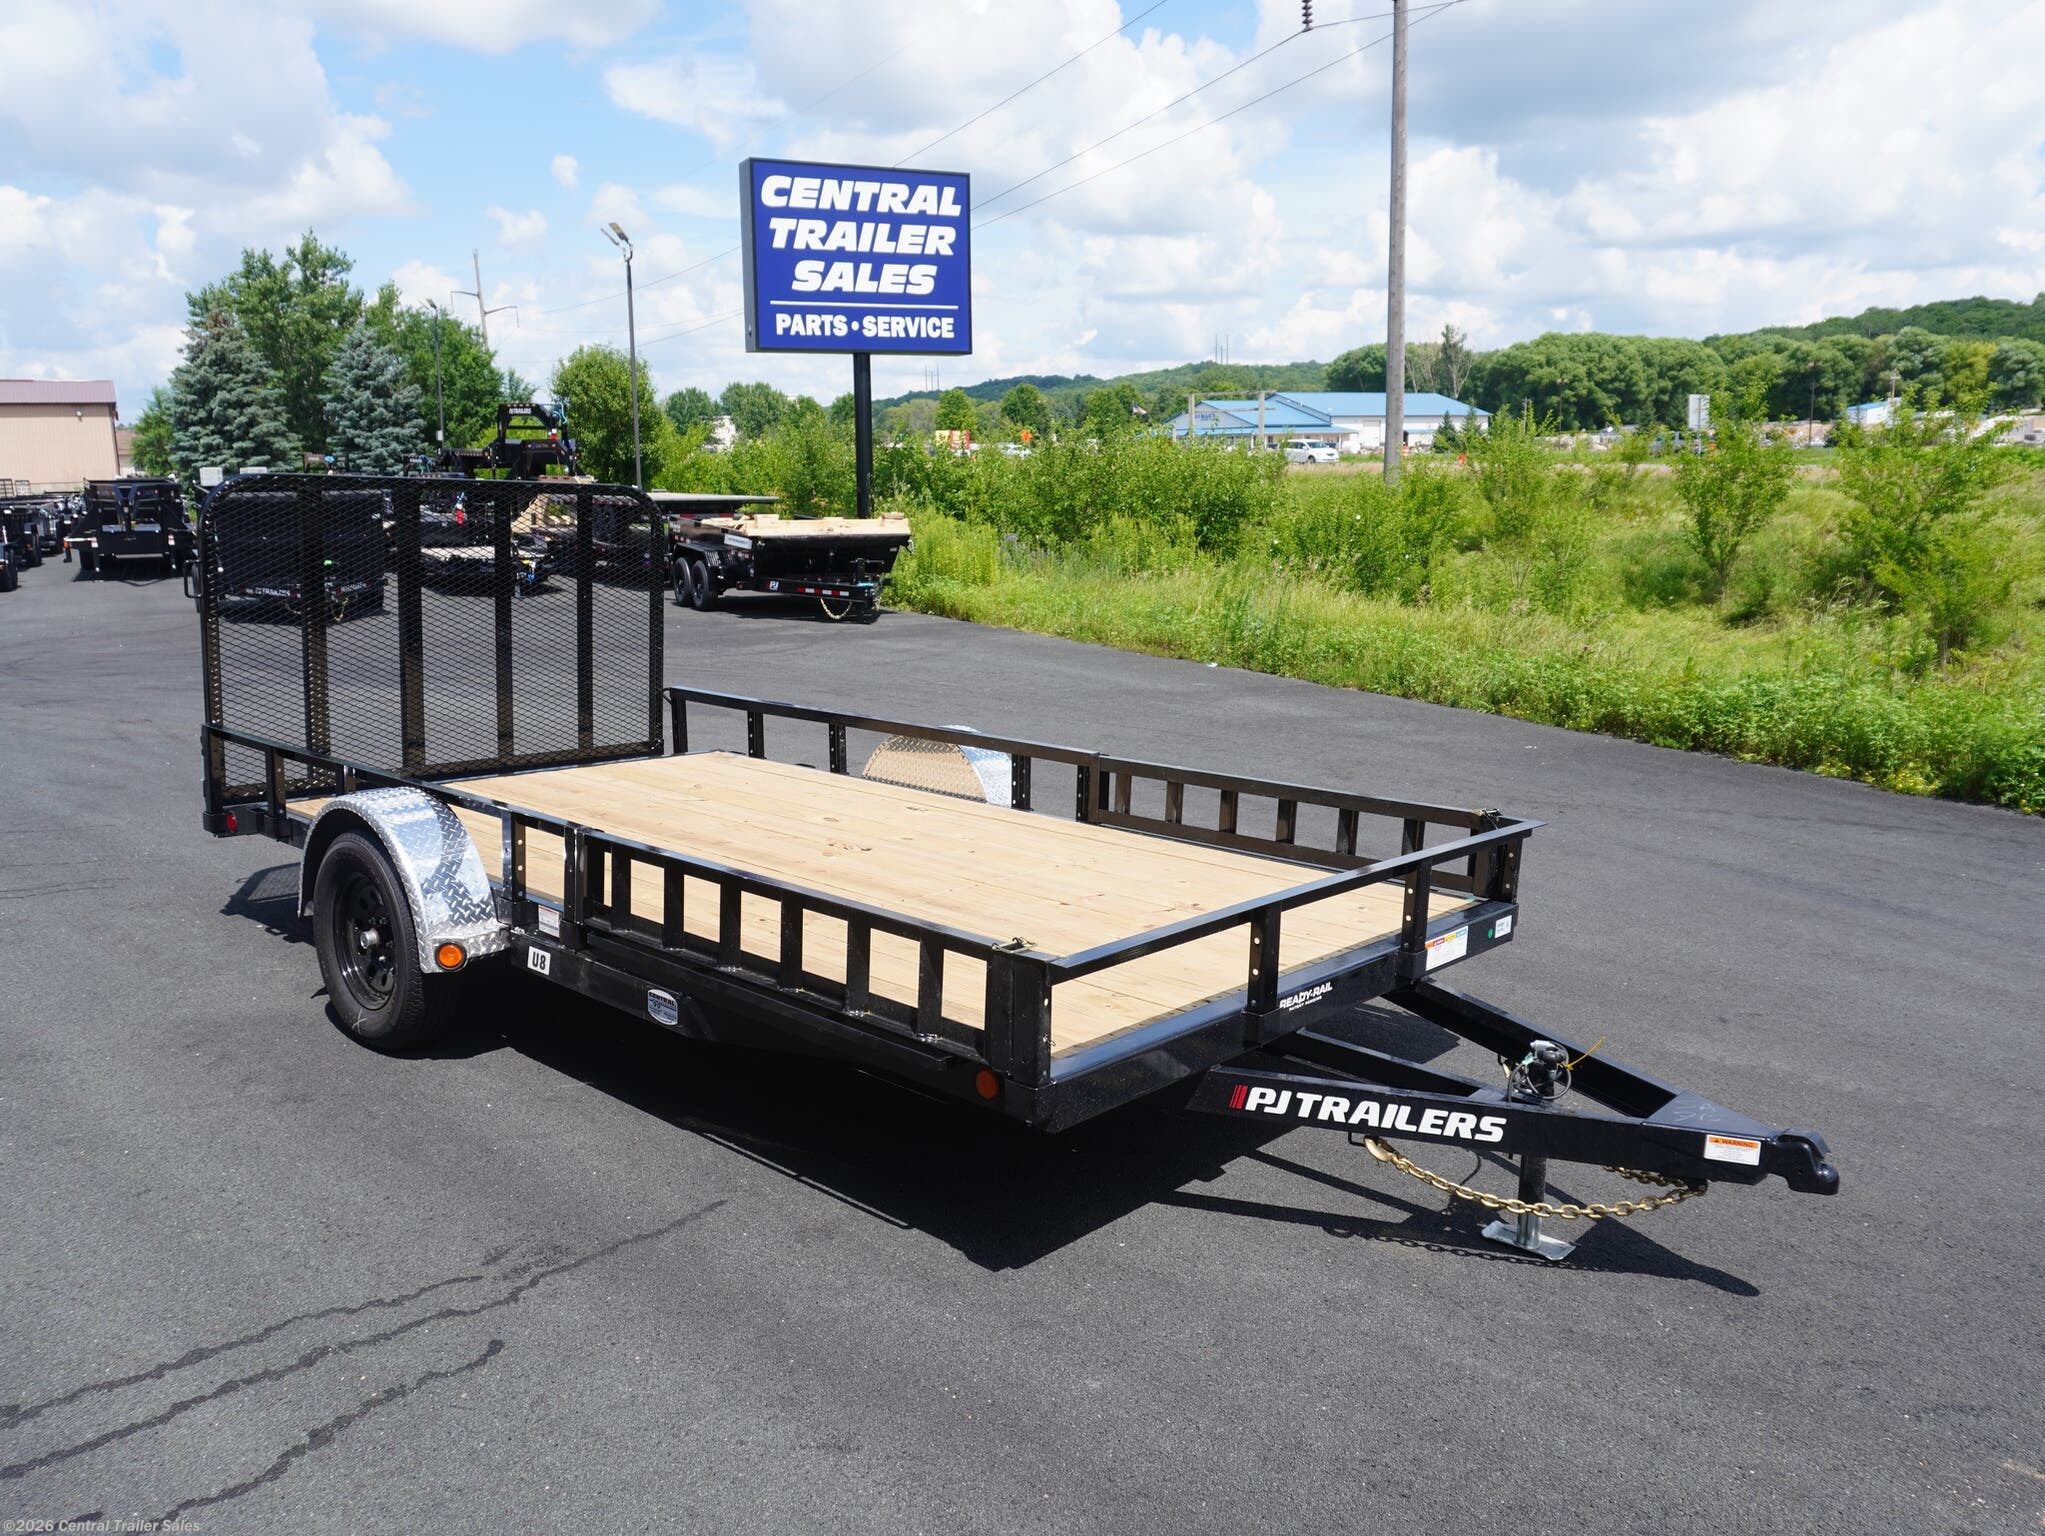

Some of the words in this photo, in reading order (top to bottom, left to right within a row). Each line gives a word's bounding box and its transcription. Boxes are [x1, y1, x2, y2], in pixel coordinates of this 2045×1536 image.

[760, 175, 962, 217] CENTRAL
[769, 217, 957, 256] TRAILER
[791, 259, 938, 295] SALES
[776, 313, 848, 336] PARTS
[862, 315, 955, 338] SERVICE
[769, 581, 779, 591] PJ
[532, 951, 546, 970] U8
[1245, 1086, 1292, 1115] PJ
[1296, 1091, 1507, 1143] TRAILERS
